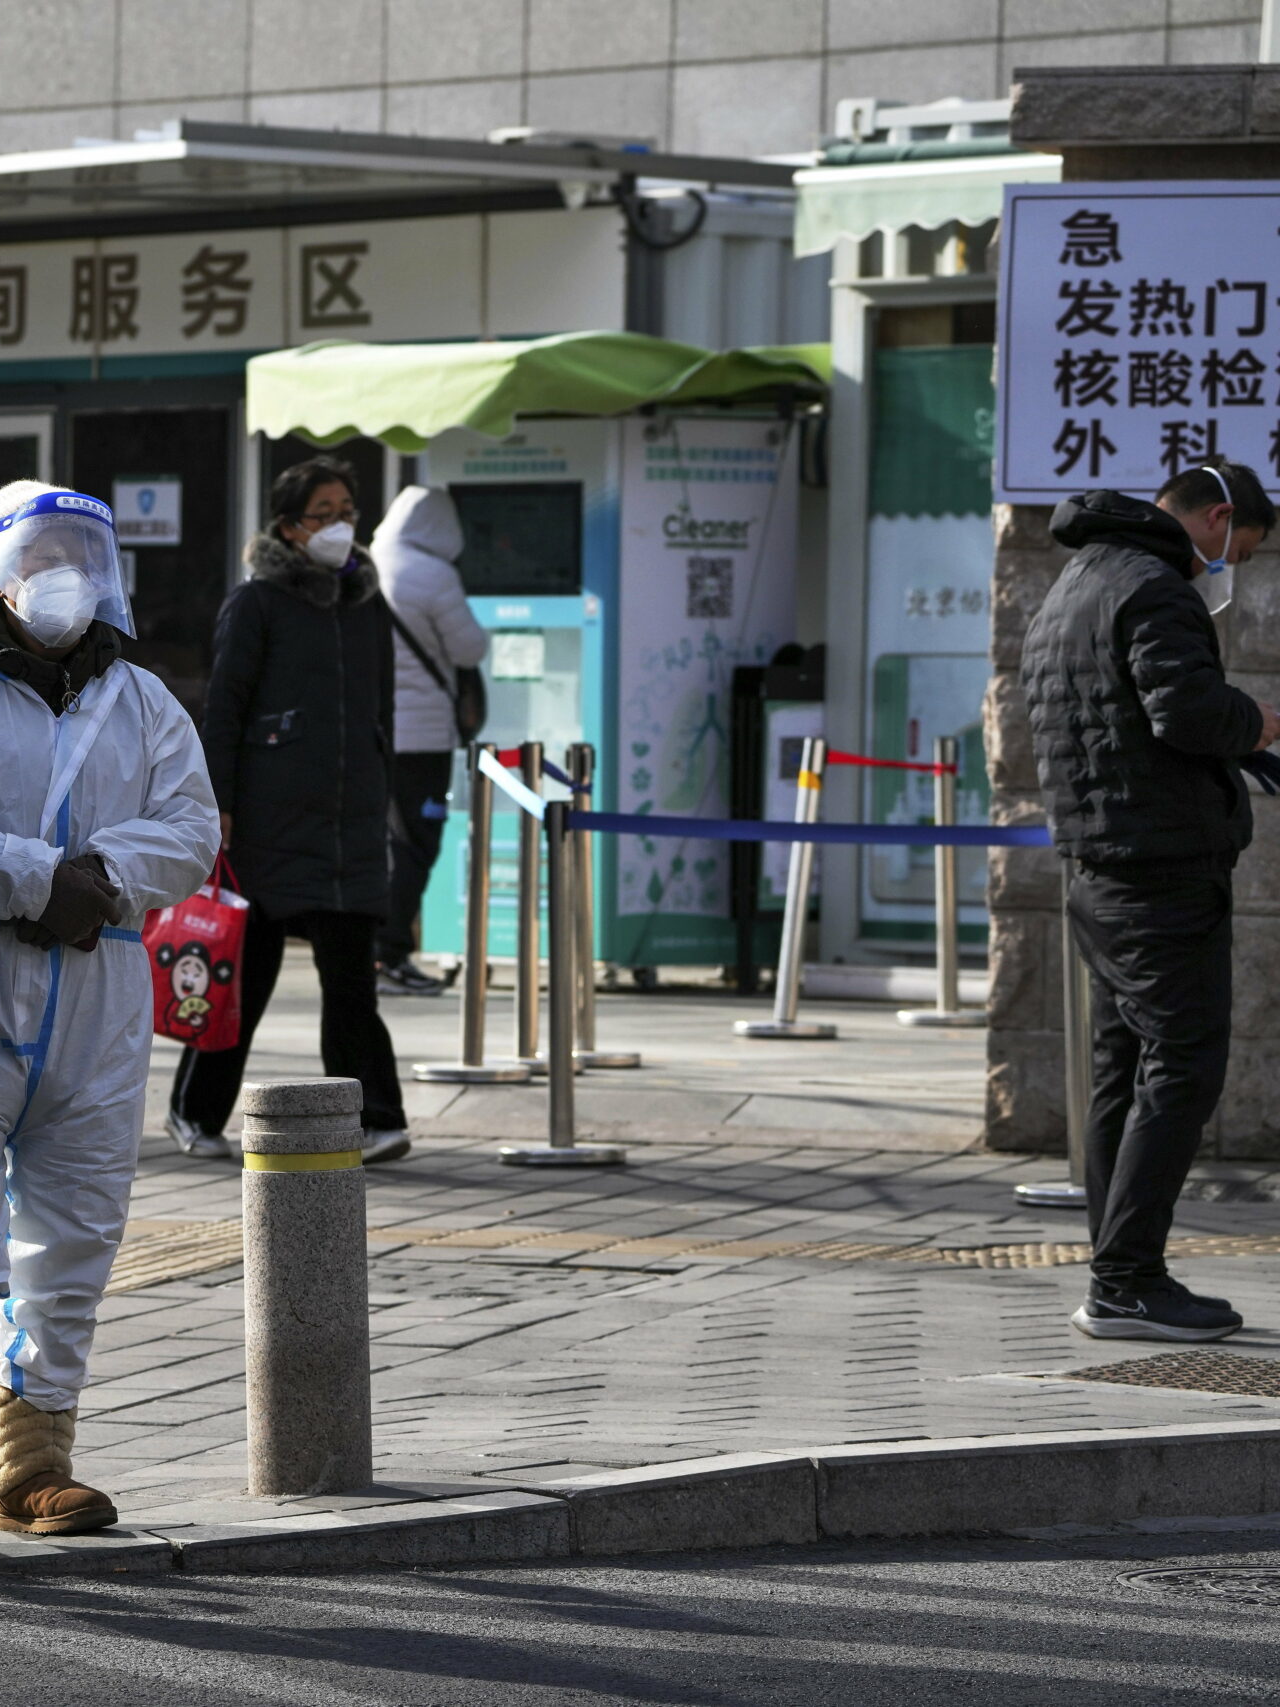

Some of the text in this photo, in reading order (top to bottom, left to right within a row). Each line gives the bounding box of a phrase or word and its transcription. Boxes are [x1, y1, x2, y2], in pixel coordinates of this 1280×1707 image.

[1055, 278, 1280, 338] 发热门
[1054, 349, 1280, 408] 核酸检
[1052, 418, 1280, 478] 外科
[662, 514, 750, 540] Cleaner
[906, 586, 991, 618] 北京协
